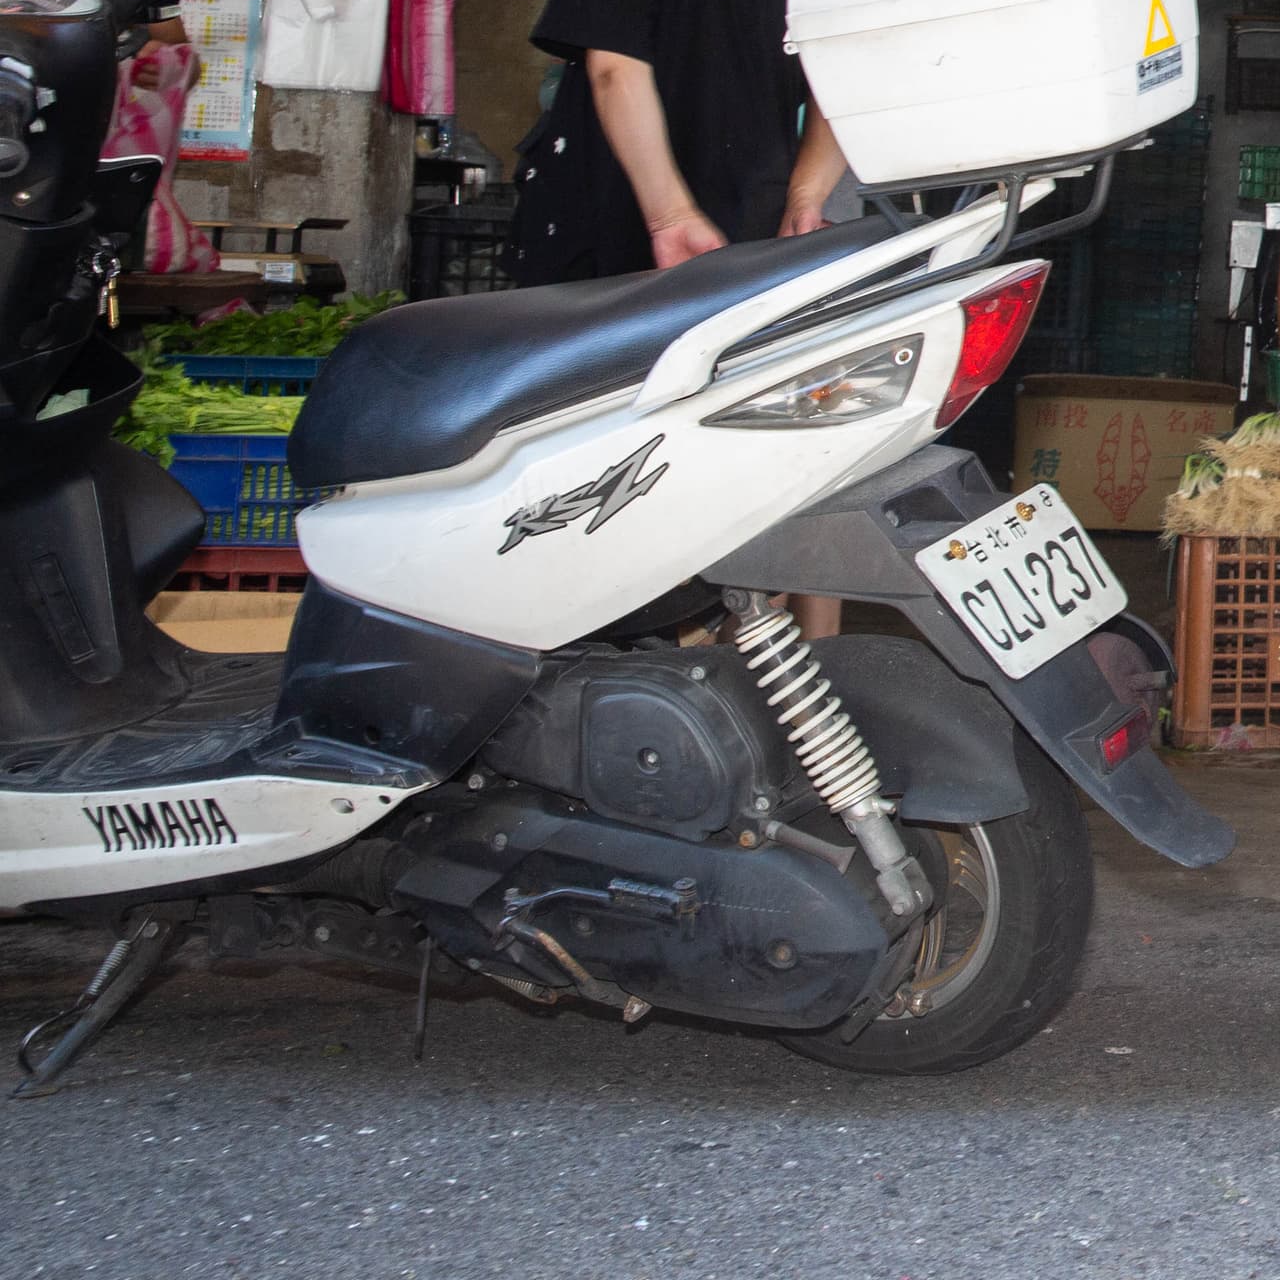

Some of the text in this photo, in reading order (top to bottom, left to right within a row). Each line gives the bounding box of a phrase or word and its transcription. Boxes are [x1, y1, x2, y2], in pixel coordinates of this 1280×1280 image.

[967, 515, 1027, 564] 台北市
[960, 526, 1107, 651] CZJ-237
[82, 798, 238, 852] YAMAHA
